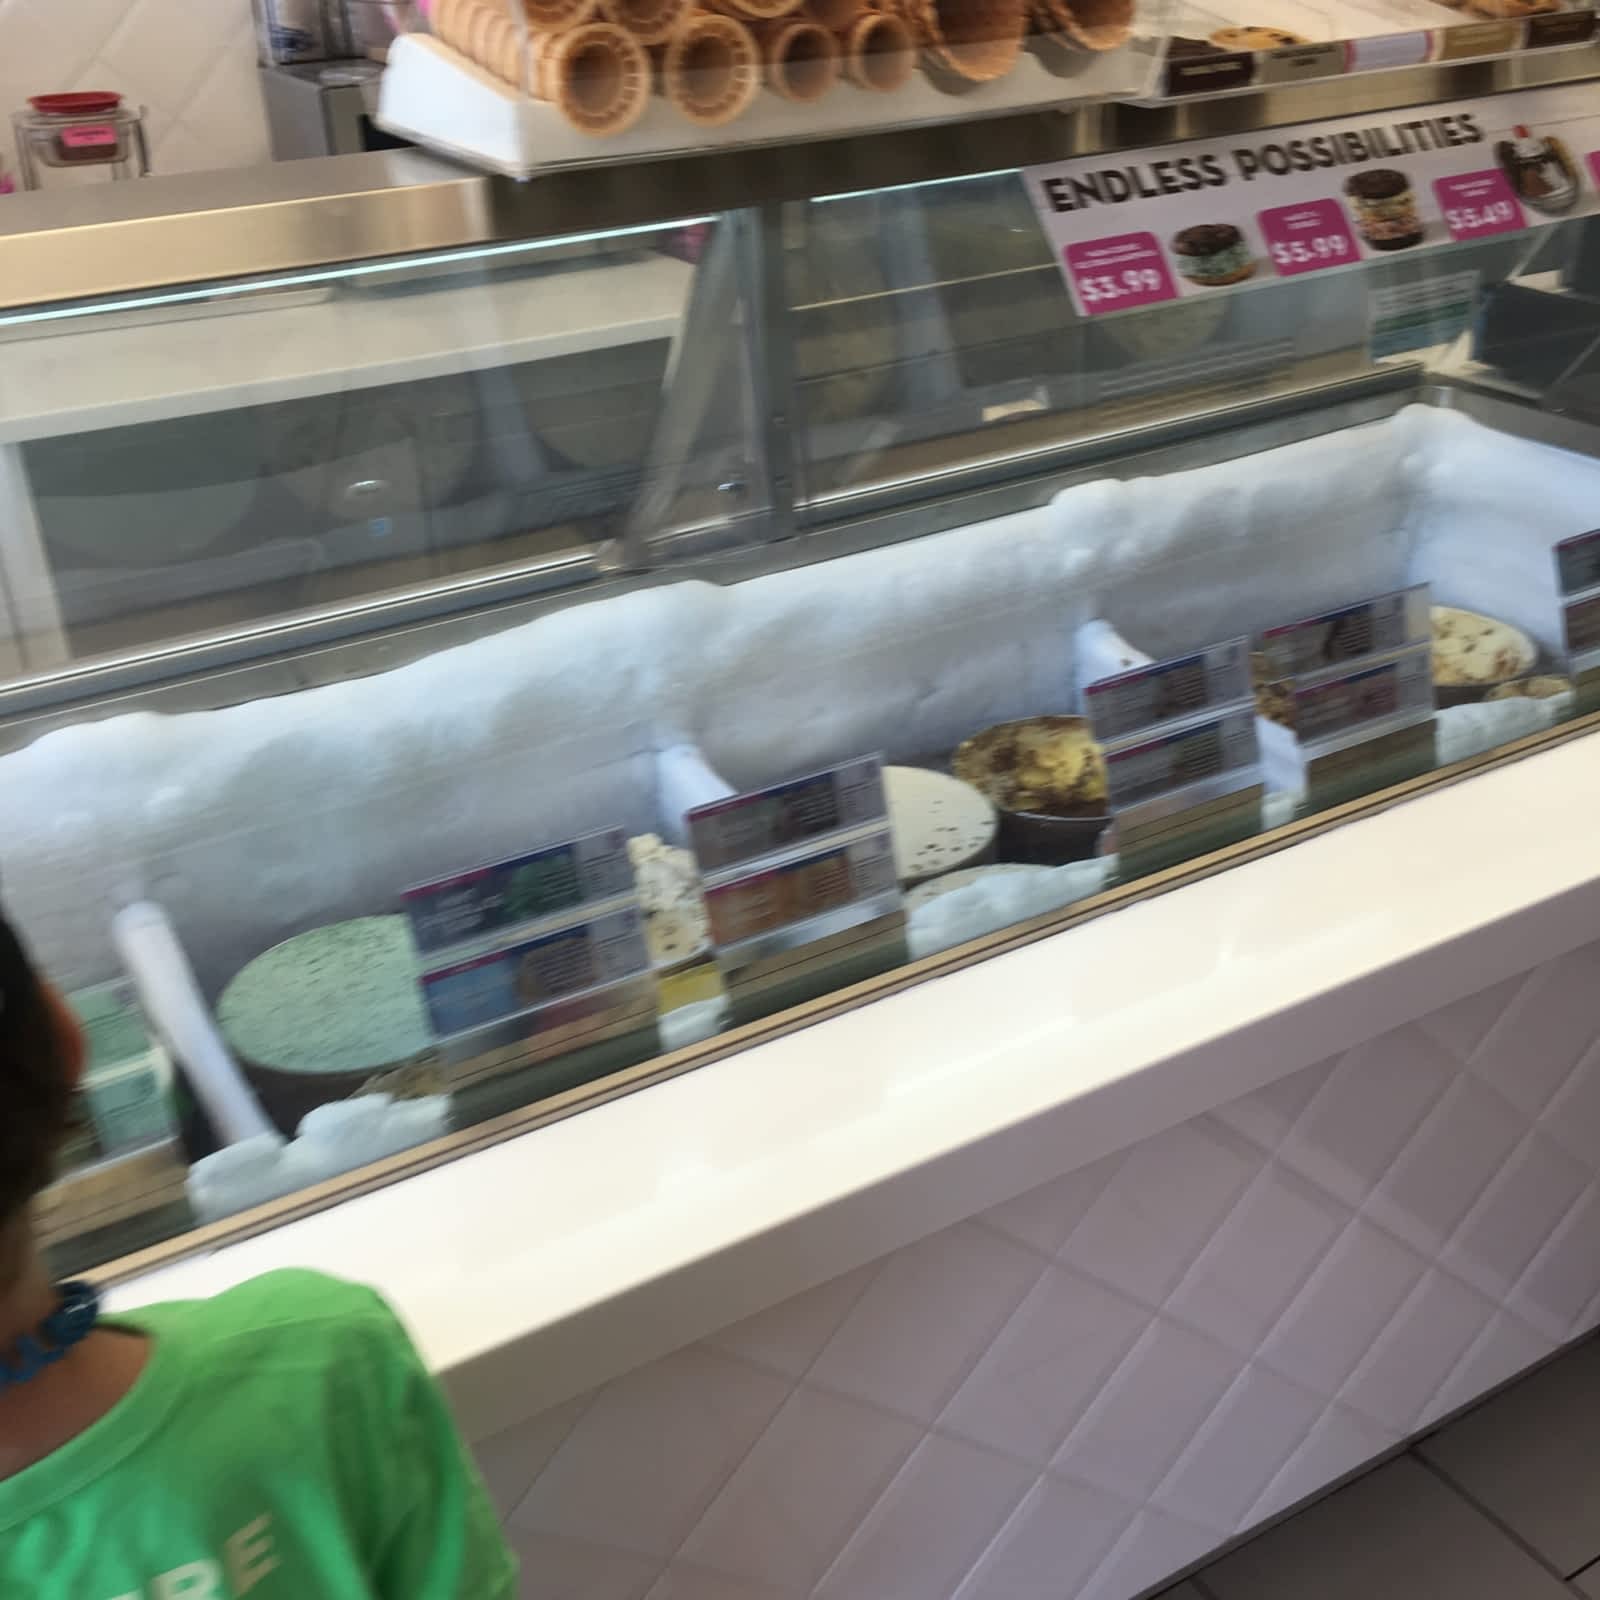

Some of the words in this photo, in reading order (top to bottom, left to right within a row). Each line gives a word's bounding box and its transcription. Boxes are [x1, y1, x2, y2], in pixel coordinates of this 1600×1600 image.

[1041, 154, 1226, 212] ENDLESS
[1231, 113, 1483, 181] POSSIBILITIES
[1272, 234, 1348, 266] $5.99
[1080, 268, 1161, 302] $3.99
[108, 1511, 281, 1600] RE
